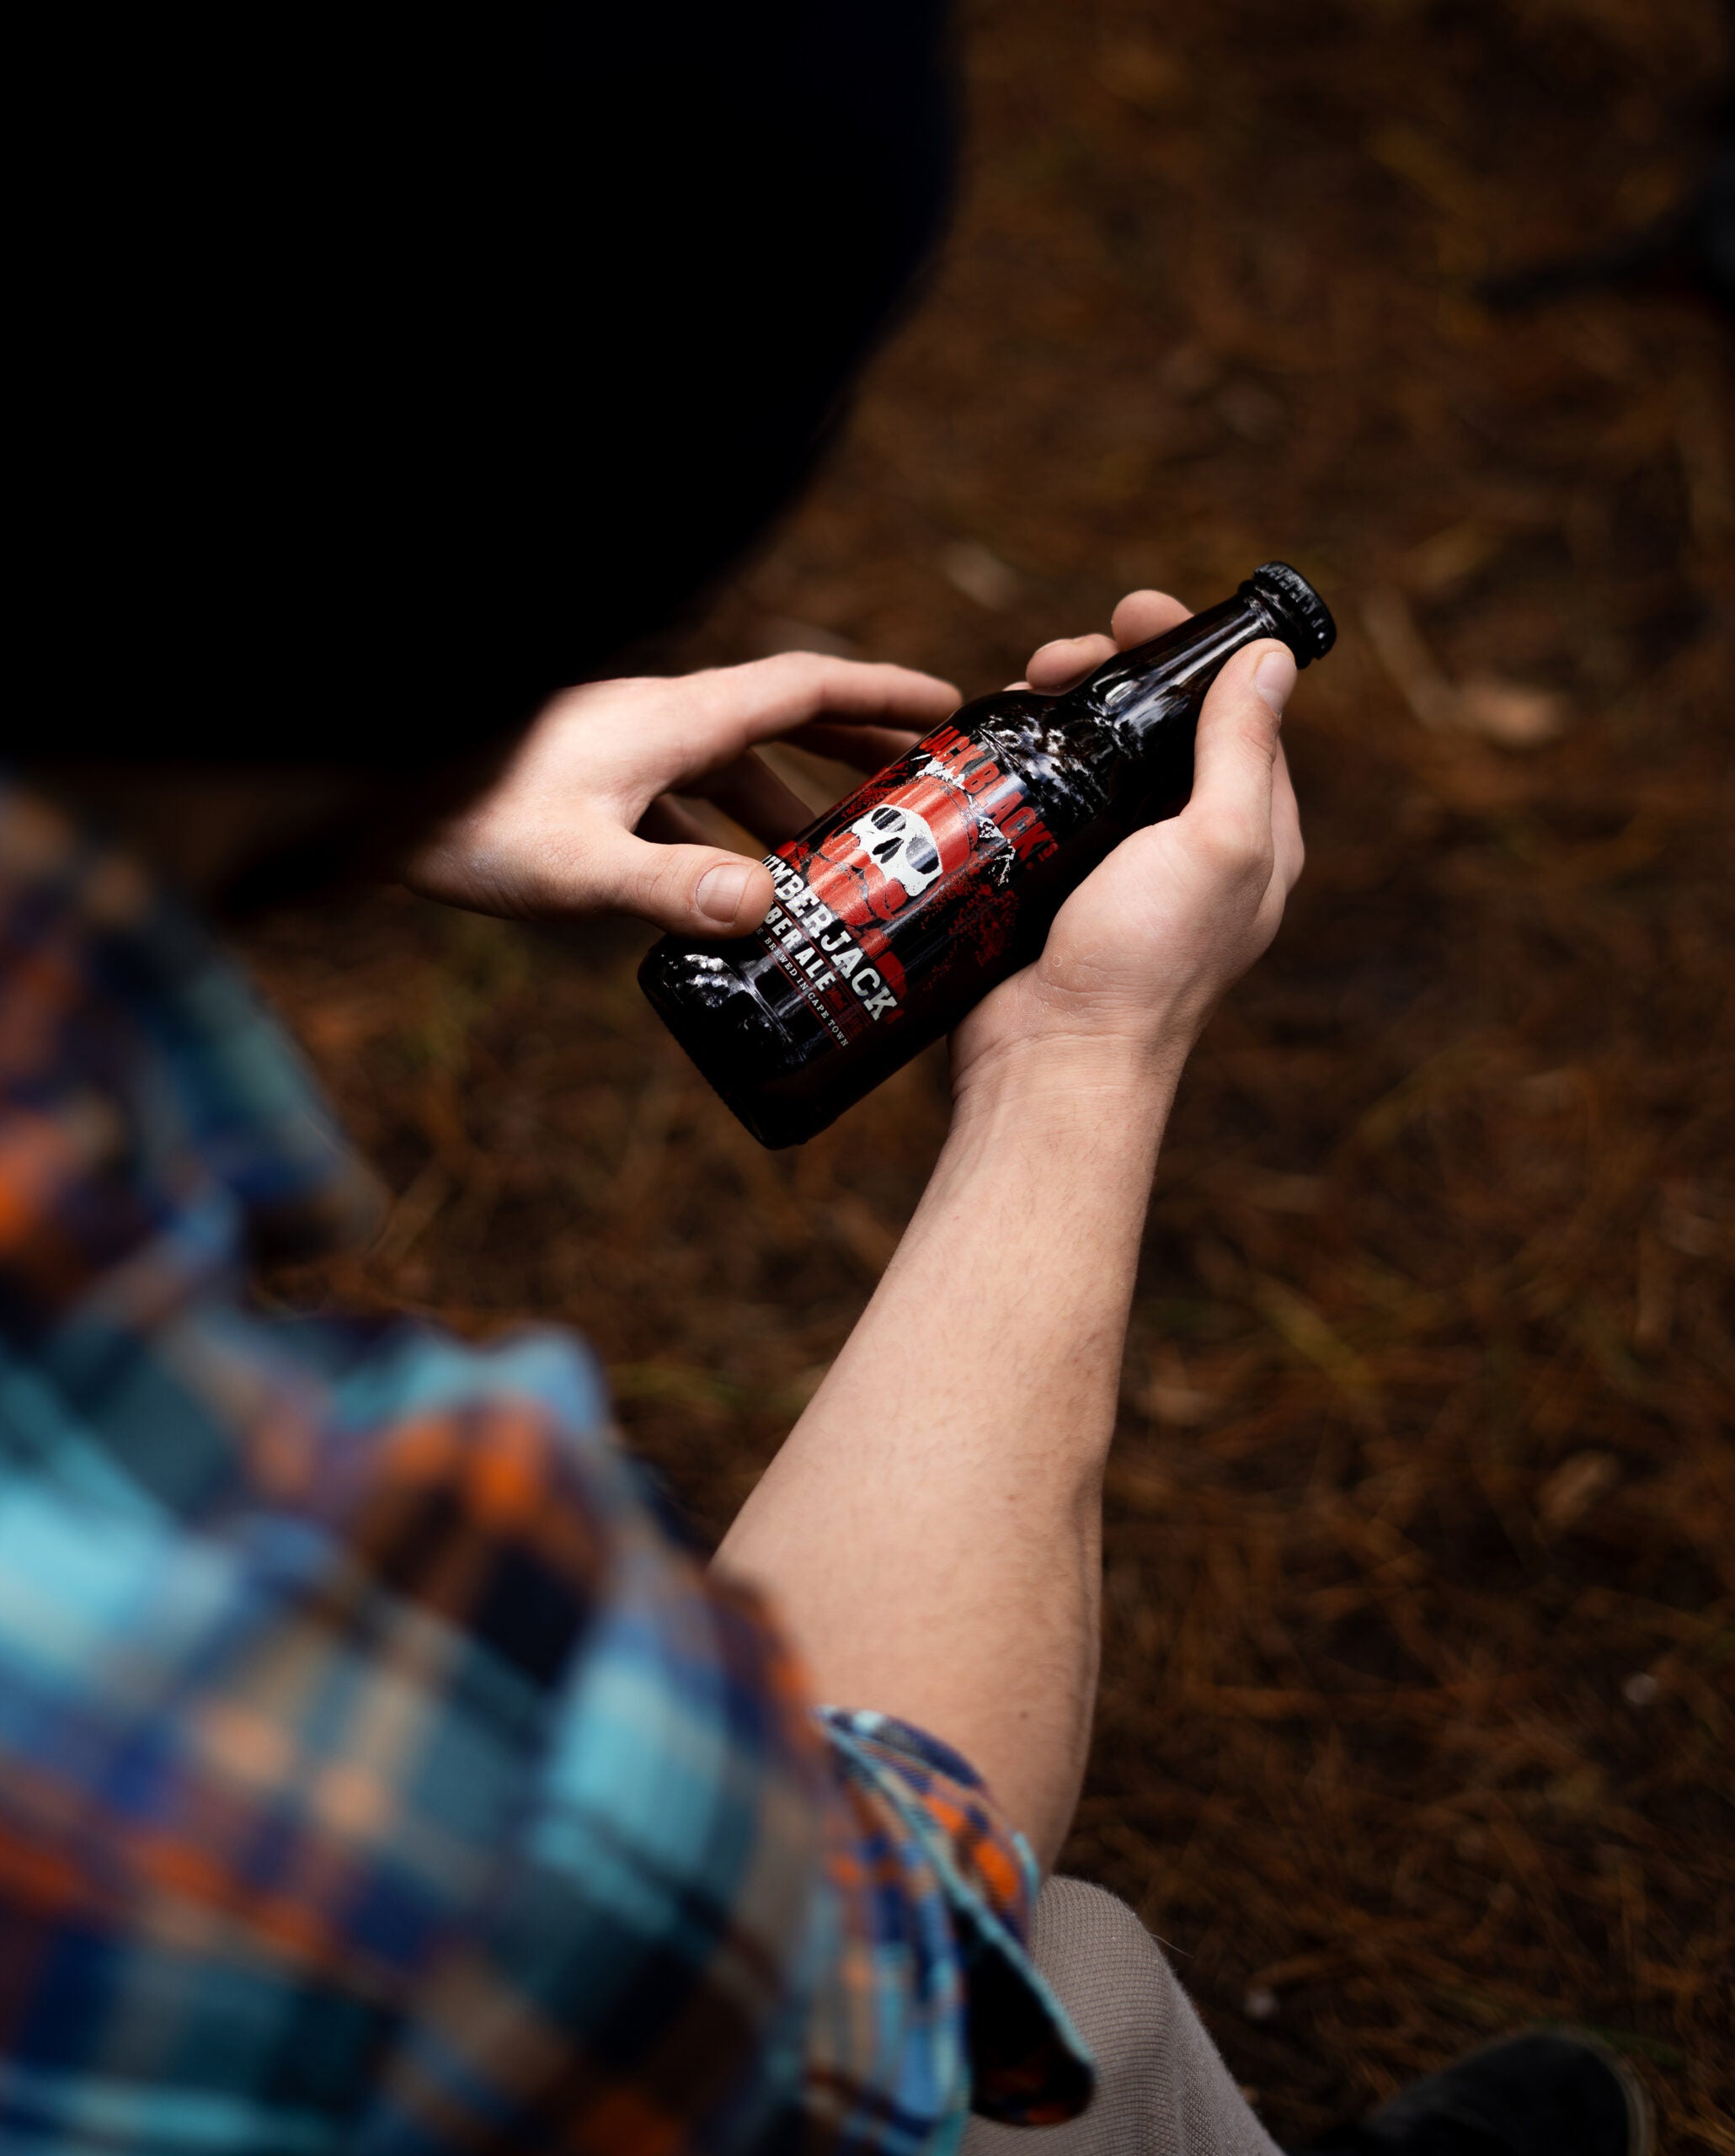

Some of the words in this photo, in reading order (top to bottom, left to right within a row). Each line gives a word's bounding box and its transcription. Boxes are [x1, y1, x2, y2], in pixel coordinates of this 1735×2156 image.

[919, 726, 985, 776] JACK
[764, 905, 803, 950] BER
[794, 947, 836, 992] ALE
[764, 937, 798, 977] BREWED
[797, 976, 809, 991] IN
[807, 991, 830, 1019] CAPE
[828, 1019, 849, 1047] TOWN
